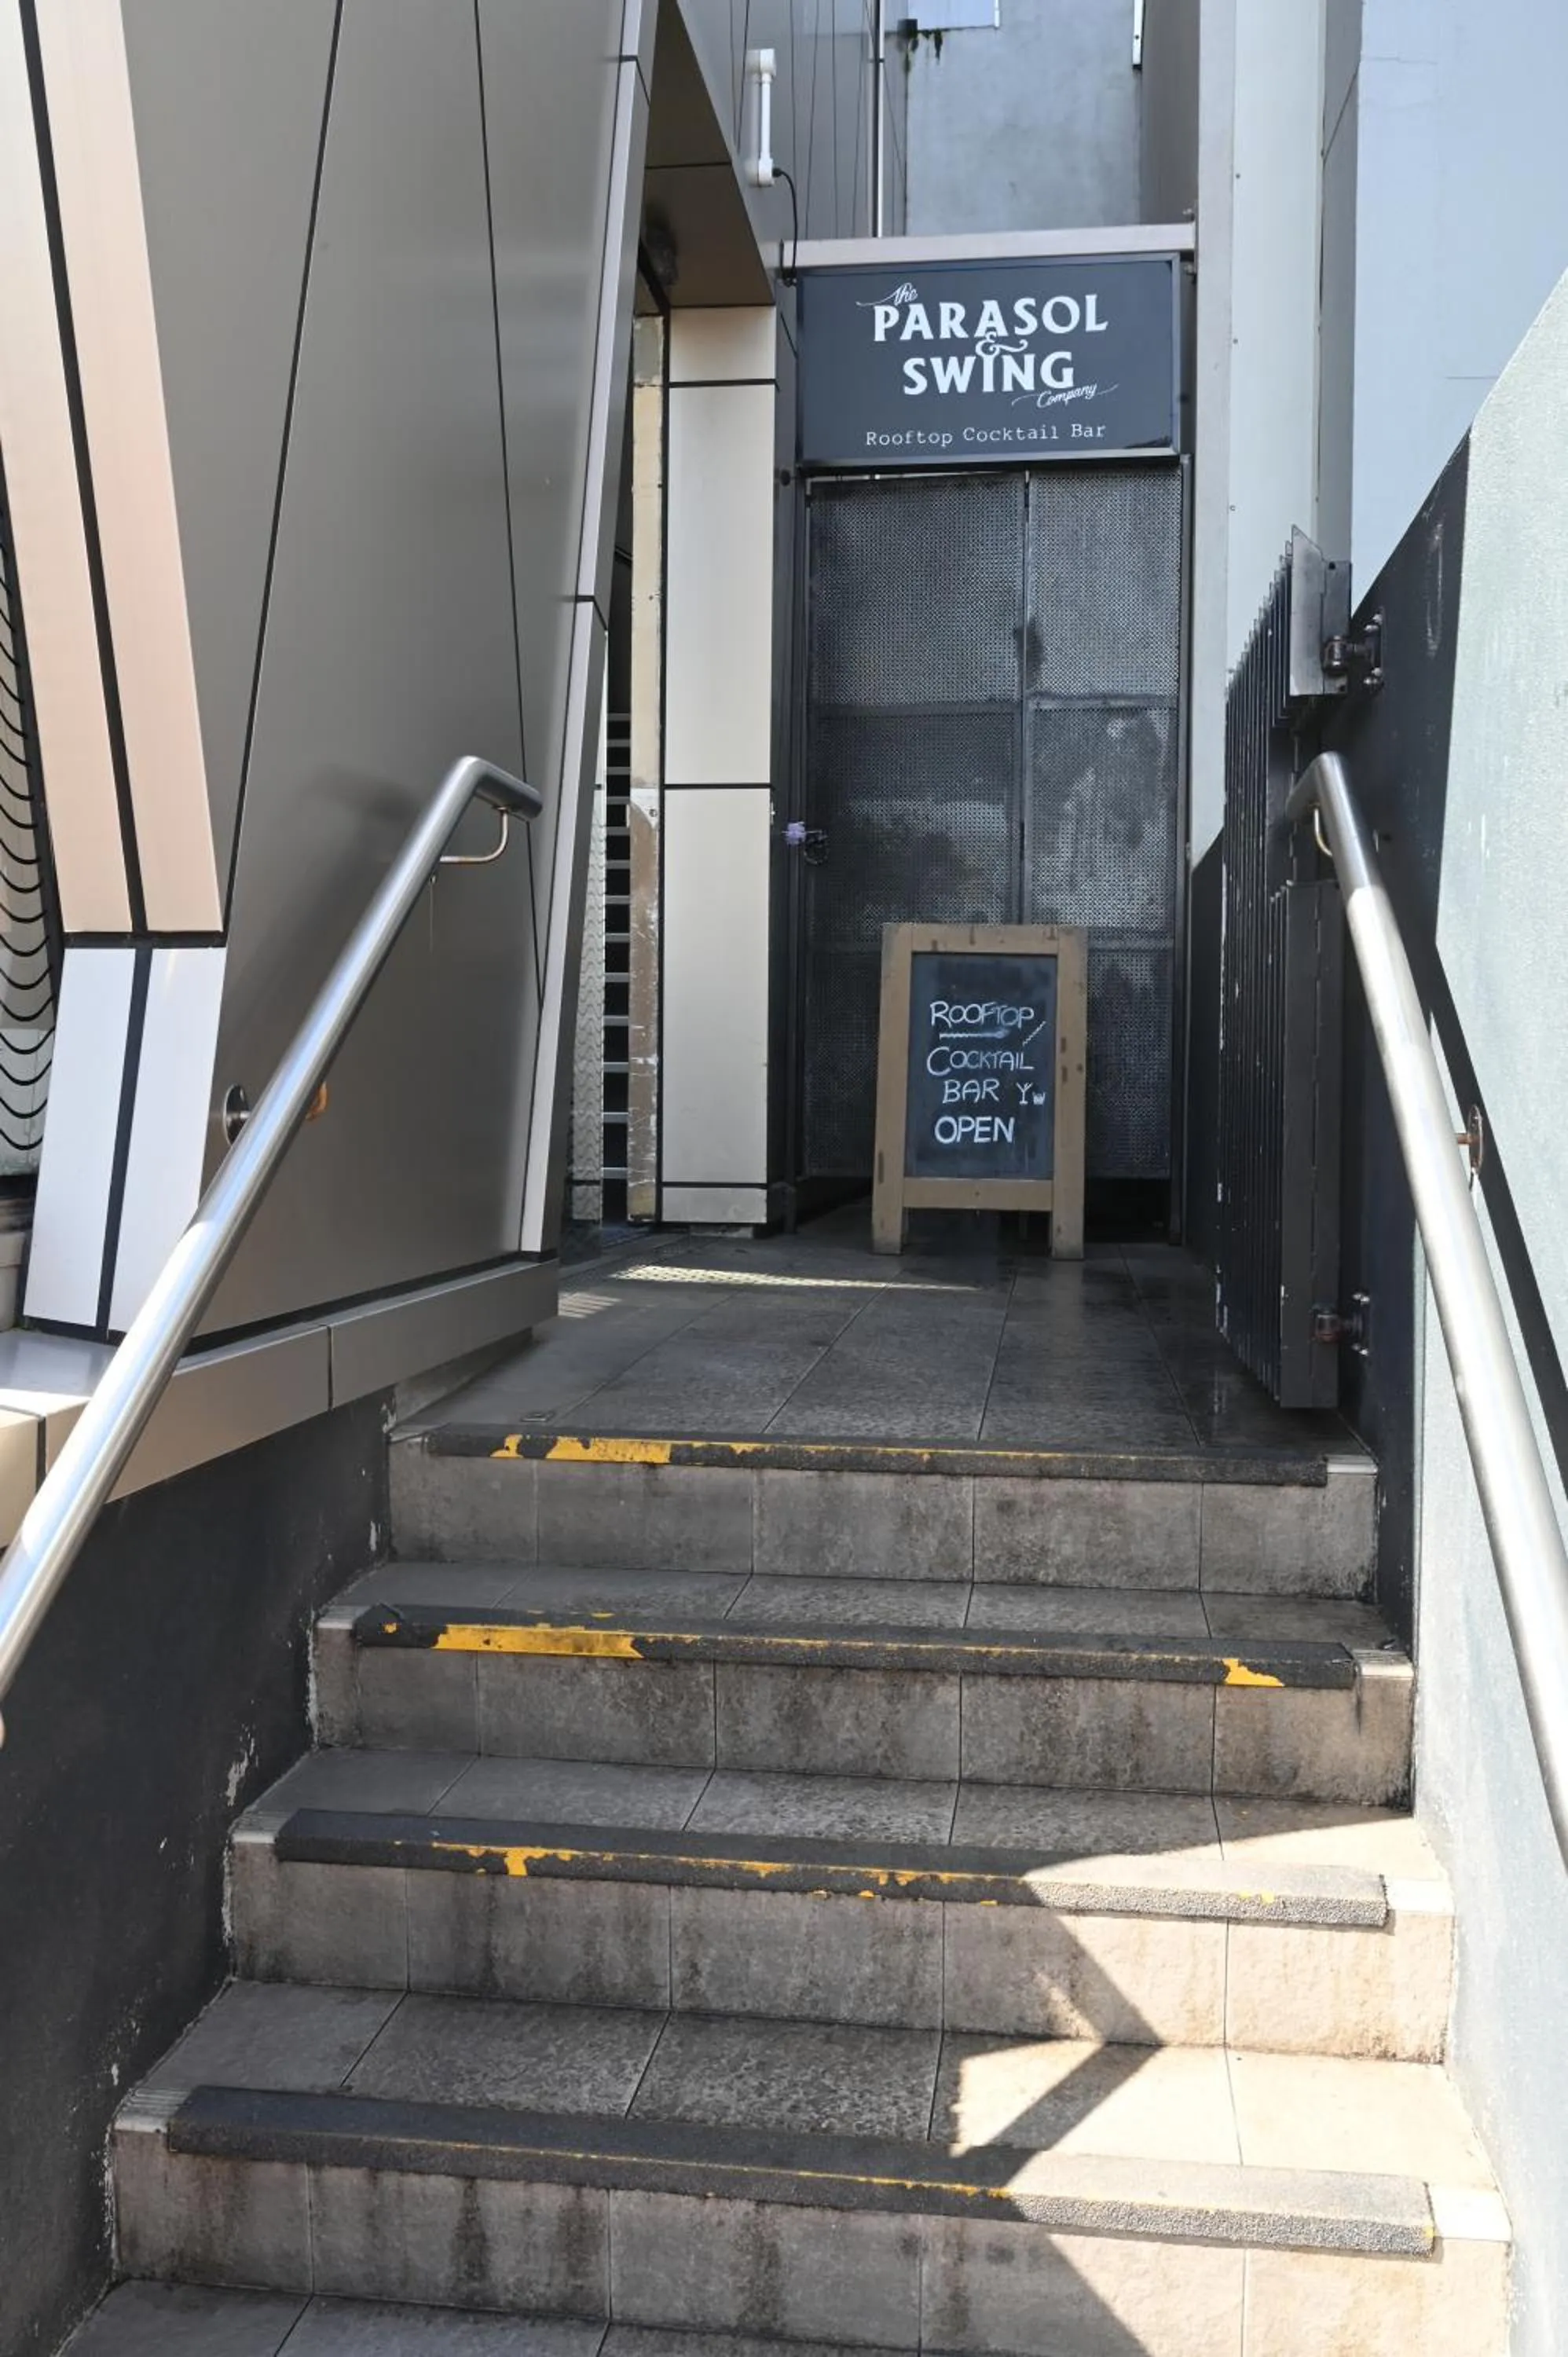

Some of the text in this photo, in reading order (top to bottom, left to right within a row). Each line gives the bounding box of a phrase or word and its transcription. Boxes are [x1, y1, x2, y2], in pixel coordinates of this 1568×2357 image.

[874, 294, 1108, 342] PARASOL
[975, 331, 1028, 359] &
[903, 351, 1074, 395] SWING
[866, 423, 1106, 446] Rooftop Cocktail Bar
[926, 1046, 1035, 1076] COCKTAIL
[943, 1079, 999, 1103] BAR
[934, 1116, 1016, 1144] OPEN
